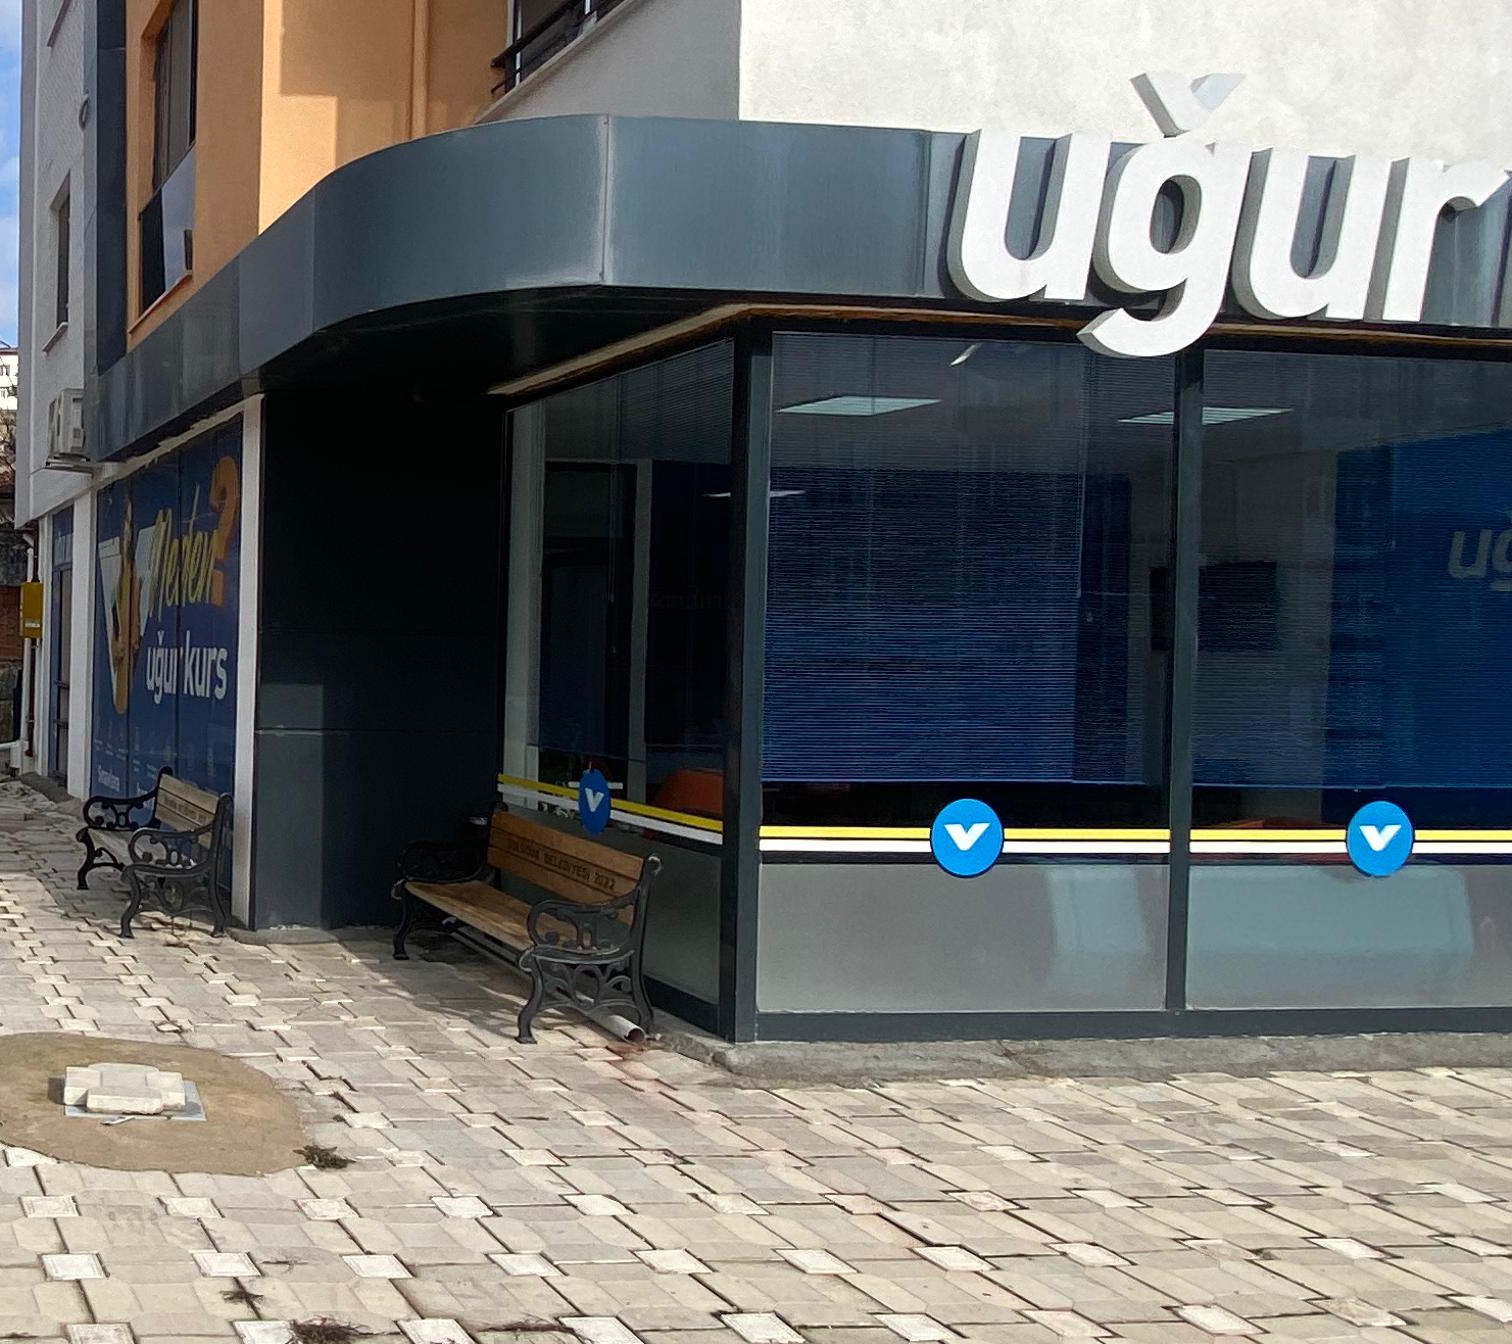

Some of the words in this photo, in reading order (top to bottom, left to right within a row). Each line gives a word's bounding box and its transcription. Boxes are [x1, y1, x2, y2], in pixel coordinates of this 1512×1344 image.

[947, 72, 1512, 357] uğur
[146, 630, 183, 704] uğur
[184, 630, 228, 700] kurs
